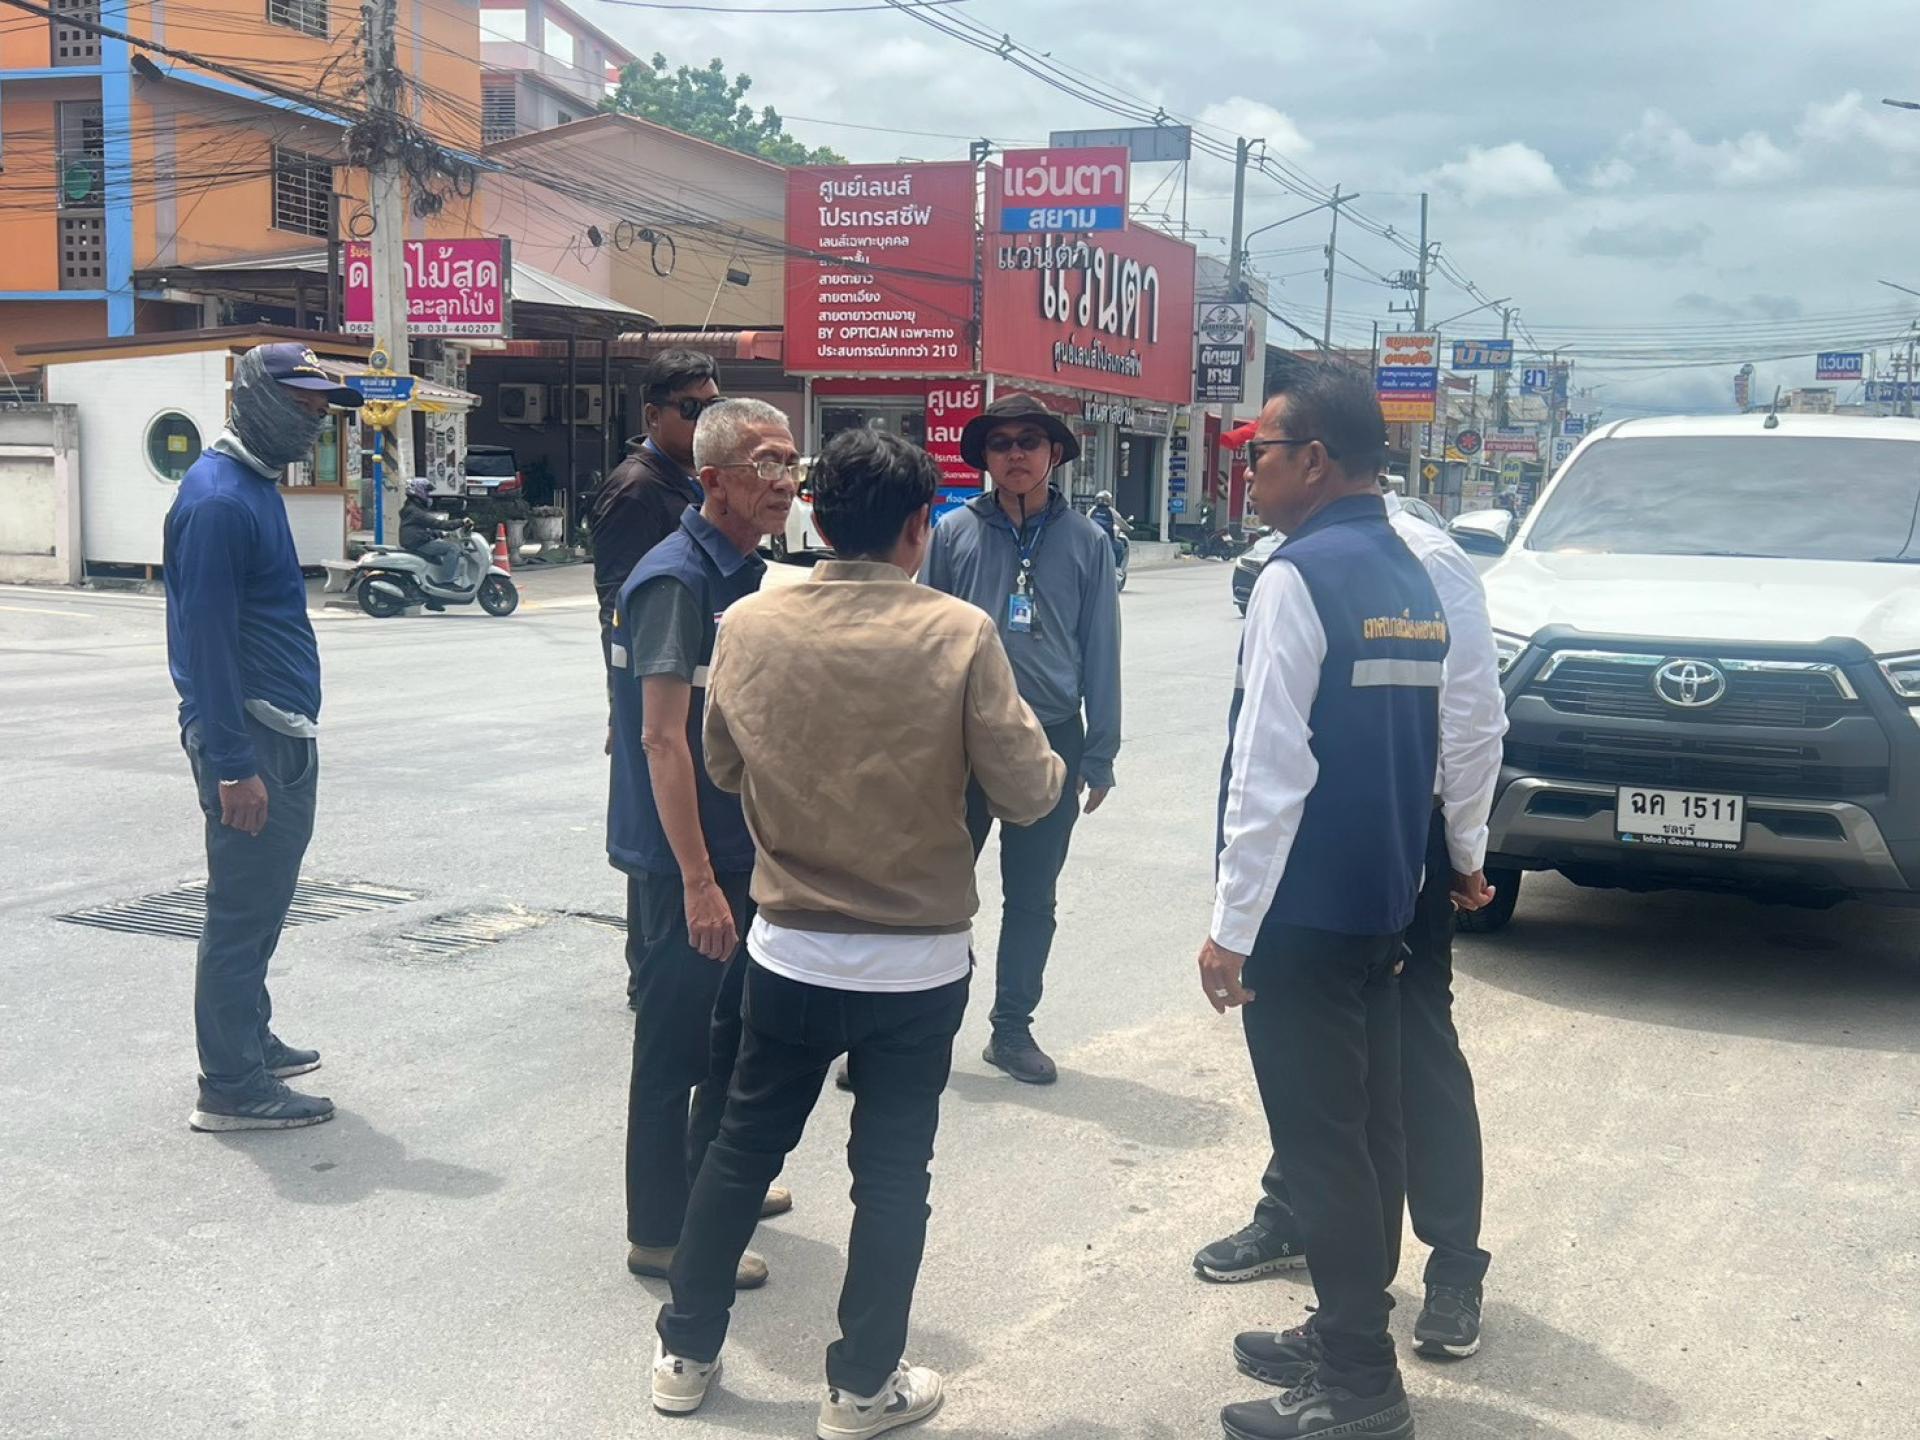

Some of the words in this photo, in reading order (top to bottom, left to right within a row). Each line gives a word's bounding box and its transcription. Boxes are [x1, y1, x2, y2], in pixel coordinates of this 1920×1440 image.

[1003, 156, 1123, 197] แว่นตา
[819, 174, 912, 203] ศูนย์เลนส์
[1028, 208, 1096, 229] สยาม
[819, 273, 874, 285] สายตายาว
[818, 311, 916, 324] สายตายาวตามอายุ
[427, 324, 495, 333] 038-440207
[818, 327, 834, 339] BY
[840, 327, 898, 339] OPTICIAN
[901, 328, 954, 339] เฉพาะทาง
[817, 344, 928, 357] ประสบการณ์มากกว่า
[927, 384, 980, 416] ศูนย์
[927, 426, 964, 442] เลน
[1631, 792, 1665, 815] ฉค
[1682, 796, 1736, 821] 1511
[1662, 824, 1697, 838] ชลบุรี
